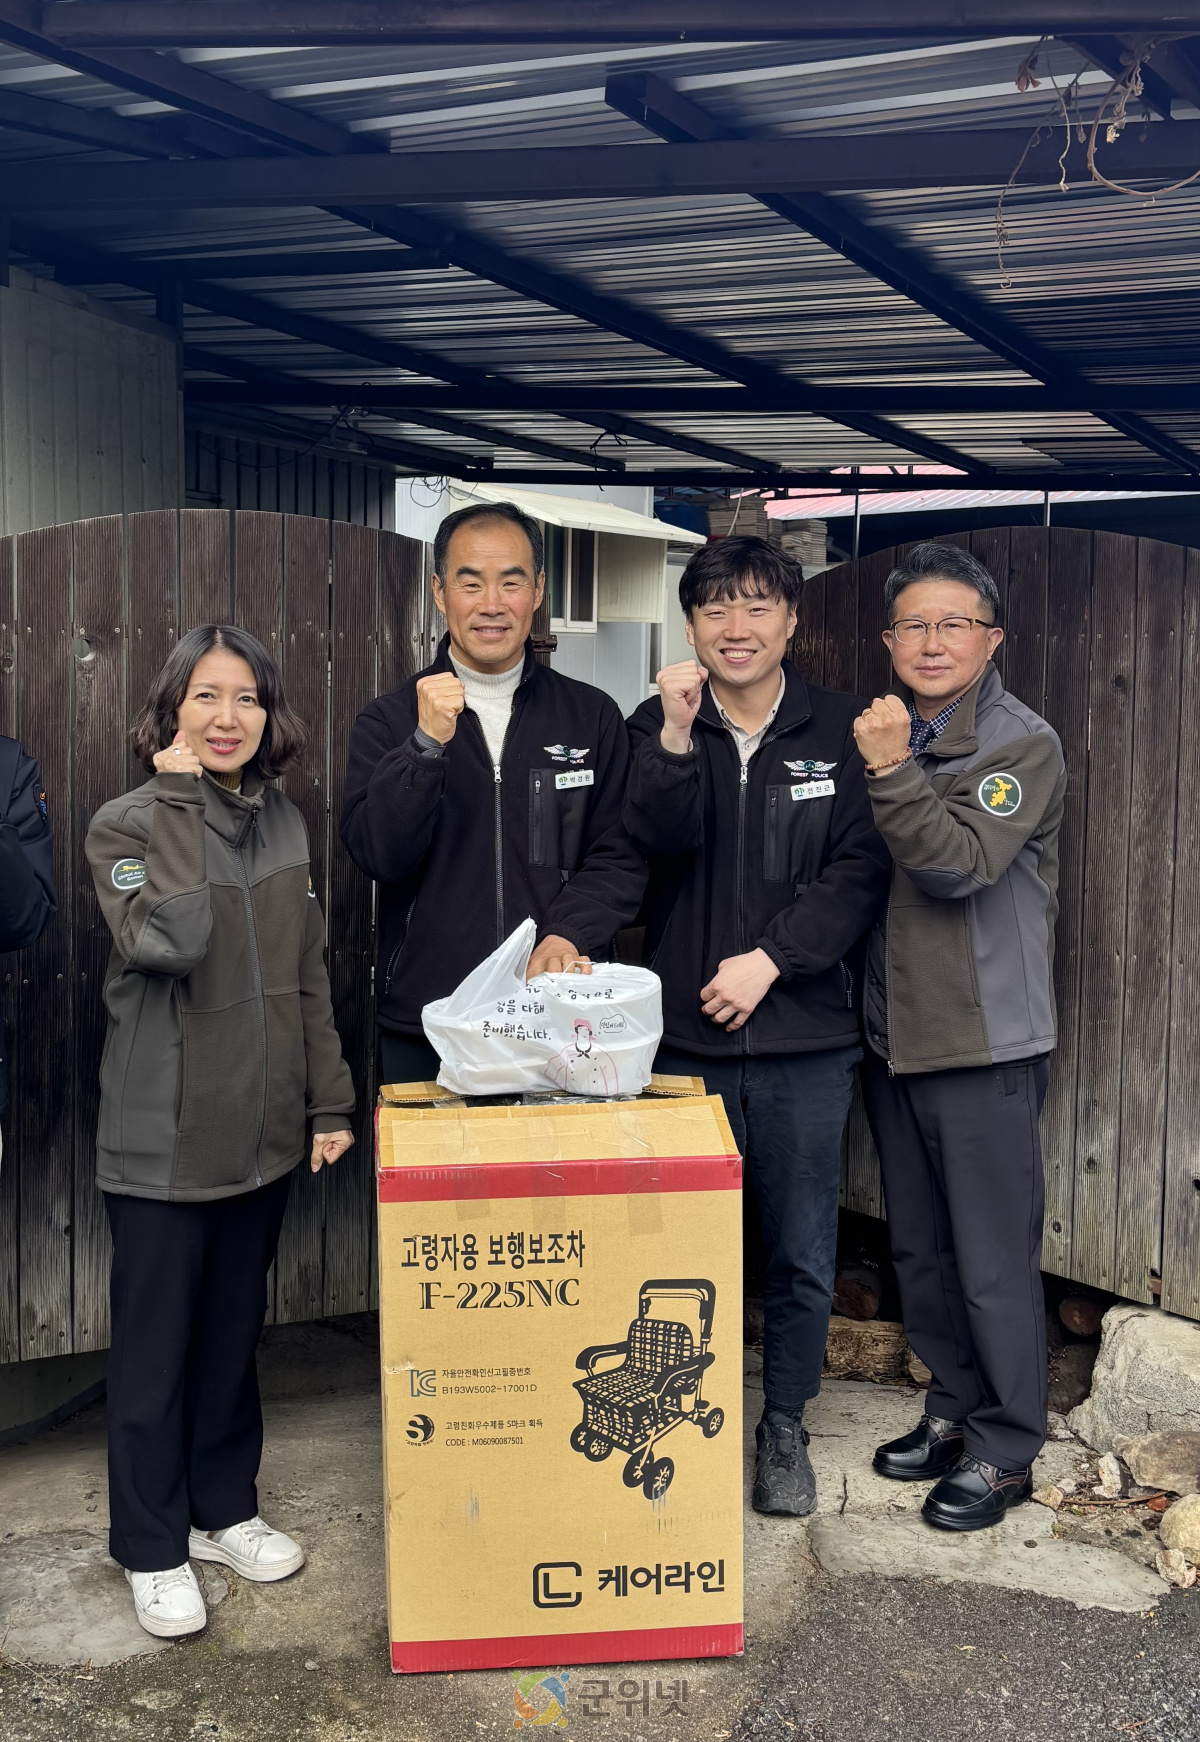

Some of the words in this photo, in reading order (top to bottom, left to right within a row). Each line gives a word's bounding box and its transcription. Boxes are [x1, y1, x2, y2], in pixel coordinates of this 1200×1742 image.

[521, 1002, 545, 1015] 다해
[482, 1020, 552, 1041] 준비했습니다.
[401, 1233, 479, 1271] 고령자용
[487, 1230, 586, 1270] 보행보조차
[418, 1278, 580, 1310] F-225NC
[442, 1367, 532, 1379] 자율안전확인신고필증번호
[442, 1384, 538, 1395] B193W5002-17001D
[445, 1420, 505, 1431] 고령친화우수제품
[506, 1419, 526, 1429] S마크
[528, 1418, 544, 1429] 획득
[445, 1438, 466, 1447] CODE
[597, 1559, 725, 1597] 케어라인
